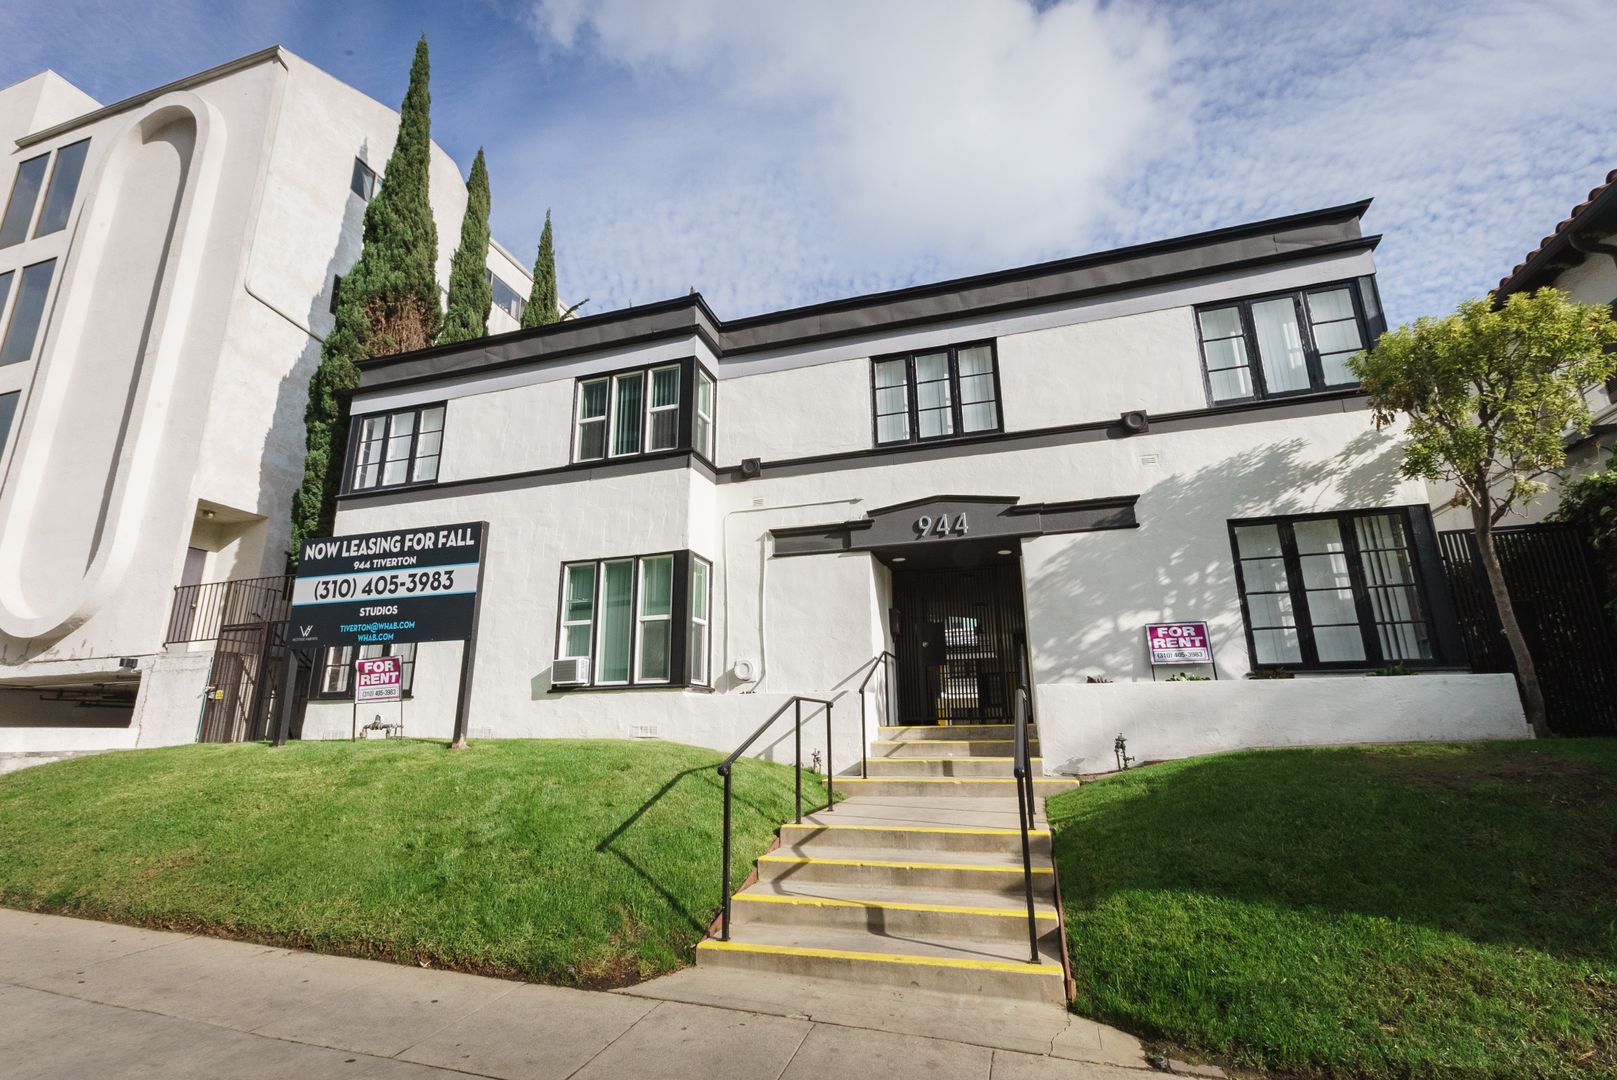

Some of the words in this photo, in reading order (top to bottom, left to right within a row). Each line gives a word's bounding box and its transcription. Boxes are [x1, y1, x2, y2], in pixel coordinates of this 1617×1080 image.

[919, 512, 969, 536] 944
[304, 541, 340, 561] NOW
[341, 534, 401, 558] LEASING
[404, 533, 435, 551] FOR
[438, 528, 475, 548] FALL
[353, 560, 371, 570] 944
[372, 556, 417, 569] TIVERTON
[314, 577, 357, 600] (310)
[361, 570, 455, 596] 405-3983
[359, 605, 399, 617] STUDIOS
[340, 621, 416, 633] TIVERTON@WHAB.COM
[1157, 626, 1196, 637] FOR
[357, 633, 395, 642] WHAB.COM
[1153, 636, 1204, 649] RENT
[364, 660, 394, 674] FOR
[360, 671, 399, 686] RENT
